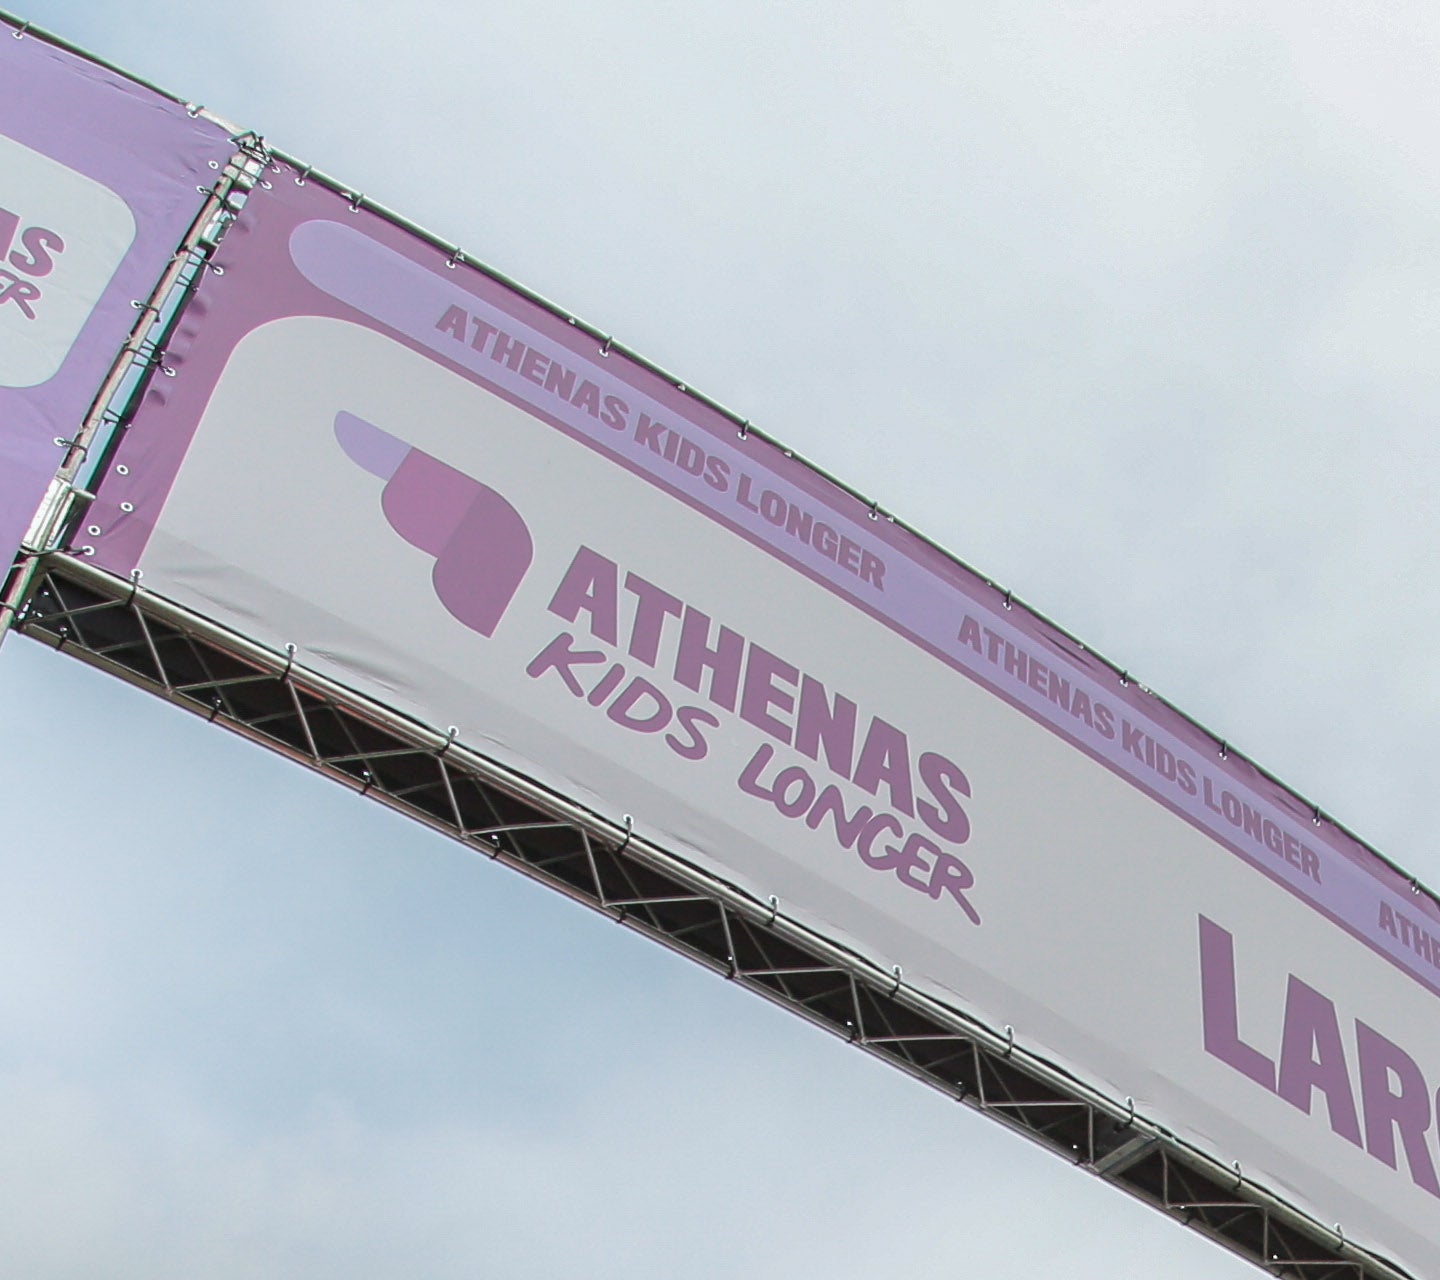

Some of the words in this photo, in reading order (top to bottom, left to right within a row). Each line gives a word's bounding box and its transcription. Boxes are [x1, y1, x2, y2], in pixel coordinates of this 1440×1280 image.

[436, 304, 629, 433] ATHENAS
[633, 413, 731, 492] KIDS
[737, 473, 887, 591] LONGER
[958, 615, 1115, 740] ATHENAS
[1121, 725, 1197, 791] KIDS
[1202, 777, 1322, 884] LONGER
[547, 545, 972, 845] ATHENAS
[526, 632, 721, 762] KIDS
[738, 741, 981, 926] LONGER
